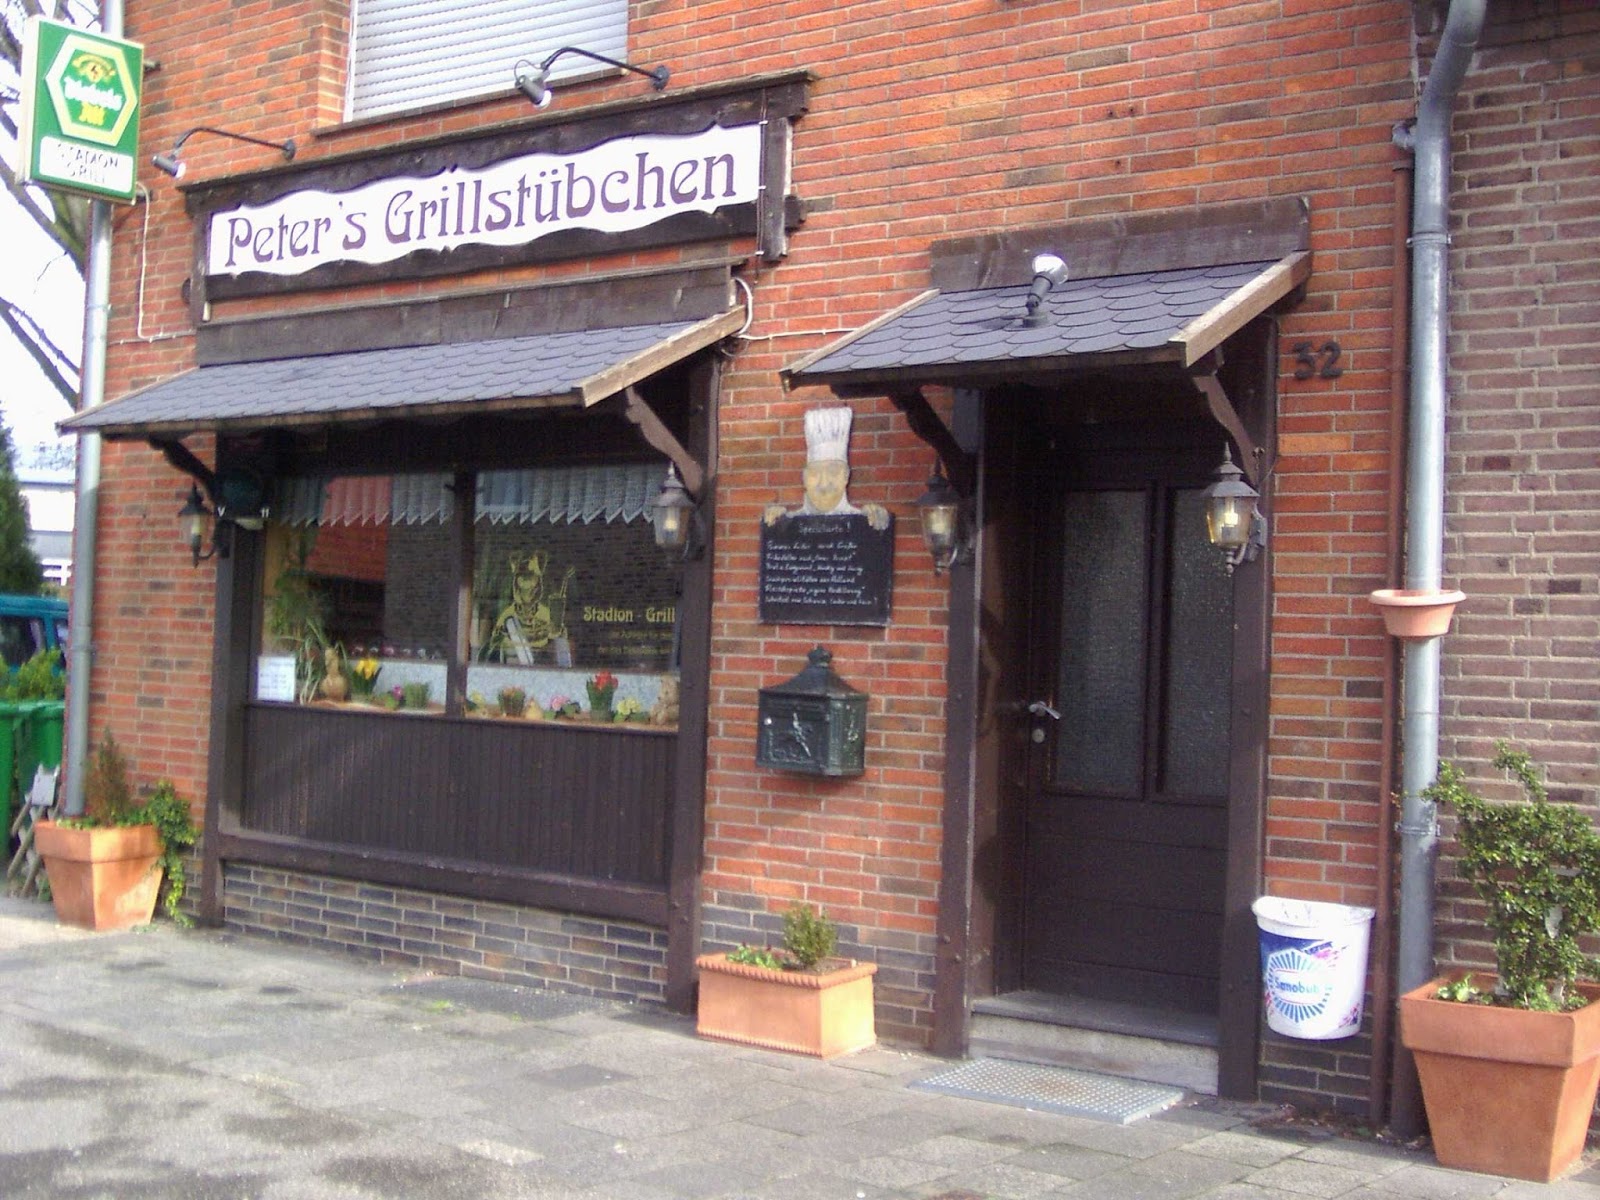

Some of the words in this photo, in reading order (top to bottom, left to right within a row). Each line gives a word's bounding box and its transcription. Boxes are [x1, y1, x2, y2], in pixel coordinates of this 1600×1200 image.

[225, 201, 367, 268] Peter's
[385, 151, 738, 244] Grillstübchen
[1293, 341, 1343, 380] 32
[583, 606, 634, 622] Stadion
[645, 606, 676, 623] Grill
